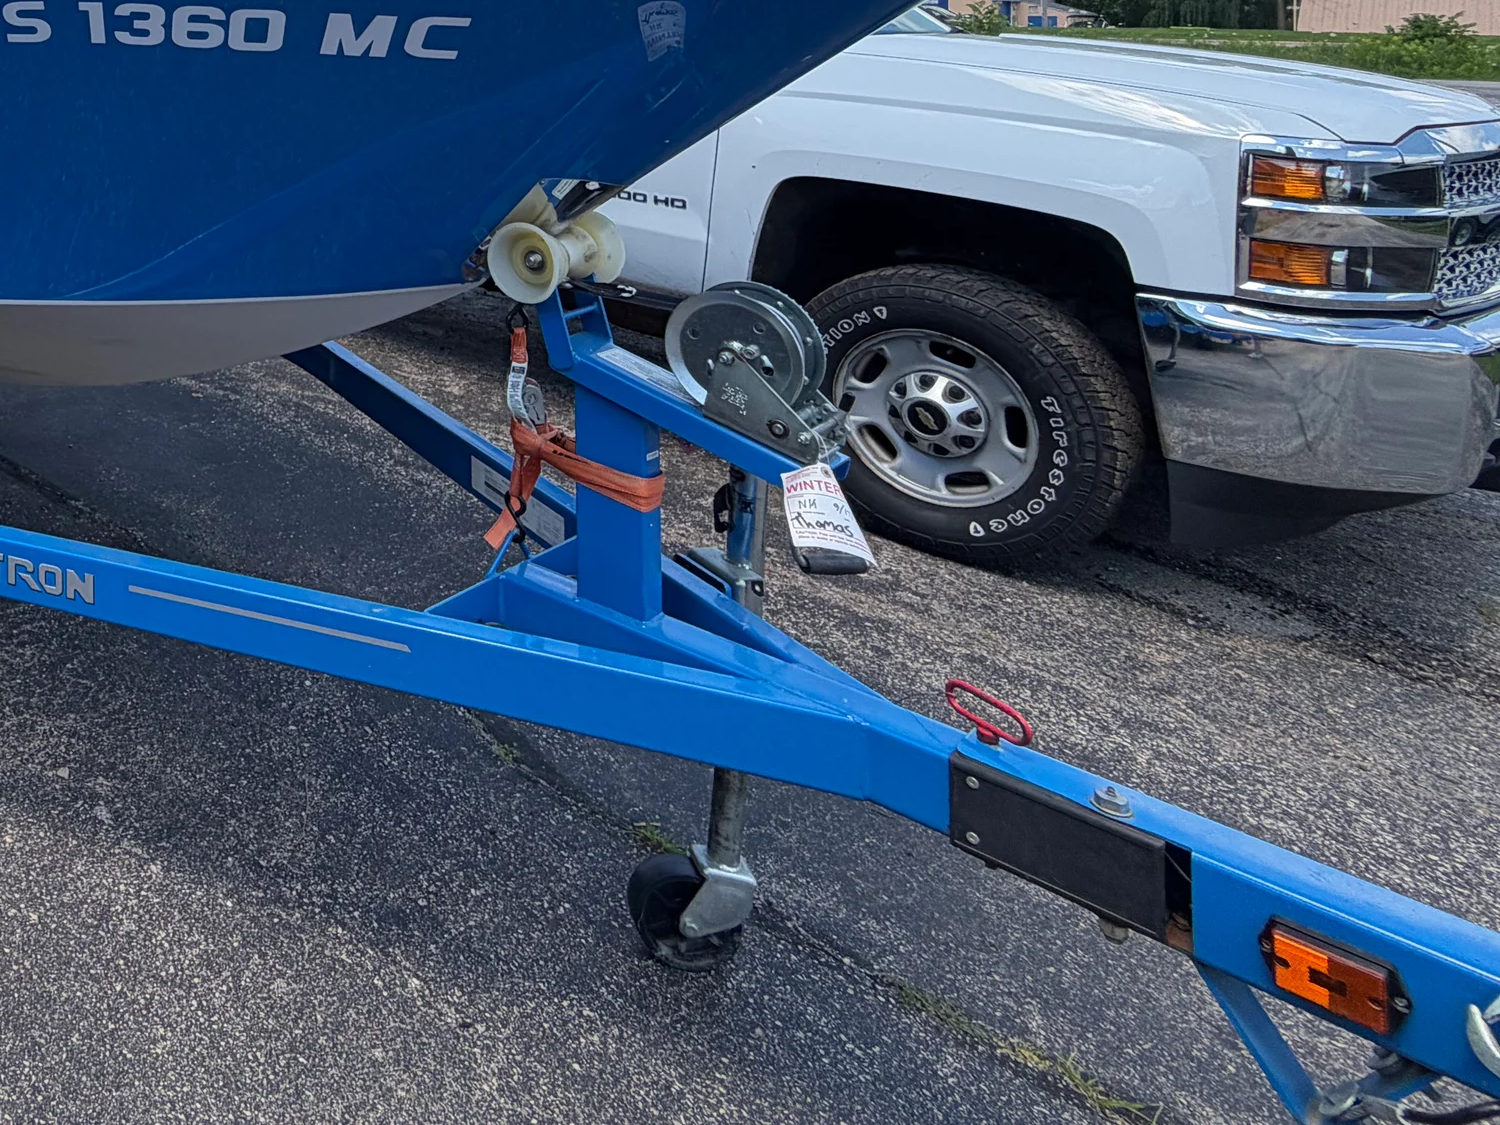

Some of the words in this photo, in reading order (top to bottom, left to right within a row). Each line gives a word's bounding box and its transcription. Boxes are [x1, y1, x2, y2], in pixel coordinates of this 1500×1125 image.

[78, 2, 286, 51] 1360
[320, 13, 472, 59] MC
[611, 190, 647, 204] 00
[653, 195, 687, 210] HD
[988, 396, 1068, 533] Firestone
